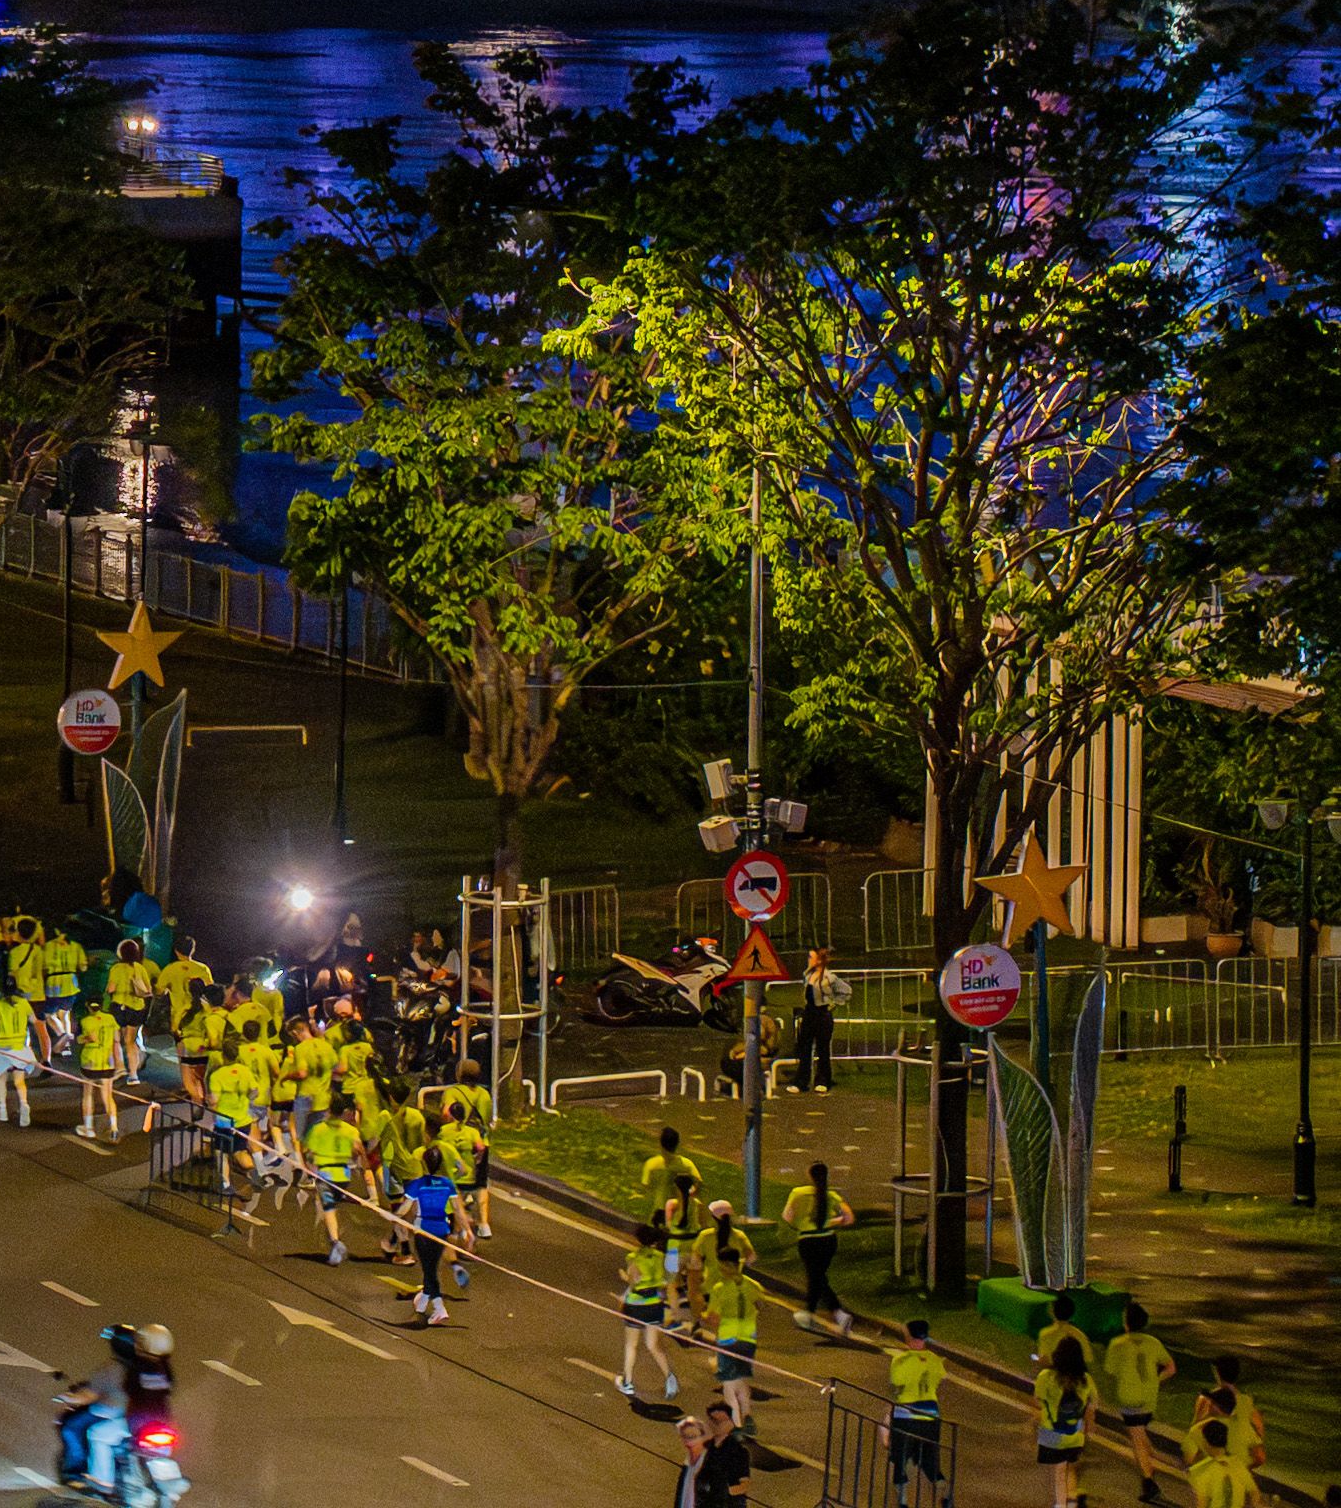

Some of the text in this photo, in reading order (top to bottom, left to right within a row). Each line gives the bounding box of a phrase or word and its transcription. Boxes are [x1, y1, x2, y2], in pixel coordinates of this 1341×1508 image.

[76, 712, 106, 724] Bank
[961, 960, 983, 976] HD
[961, 973, 1000, 991] Bank
